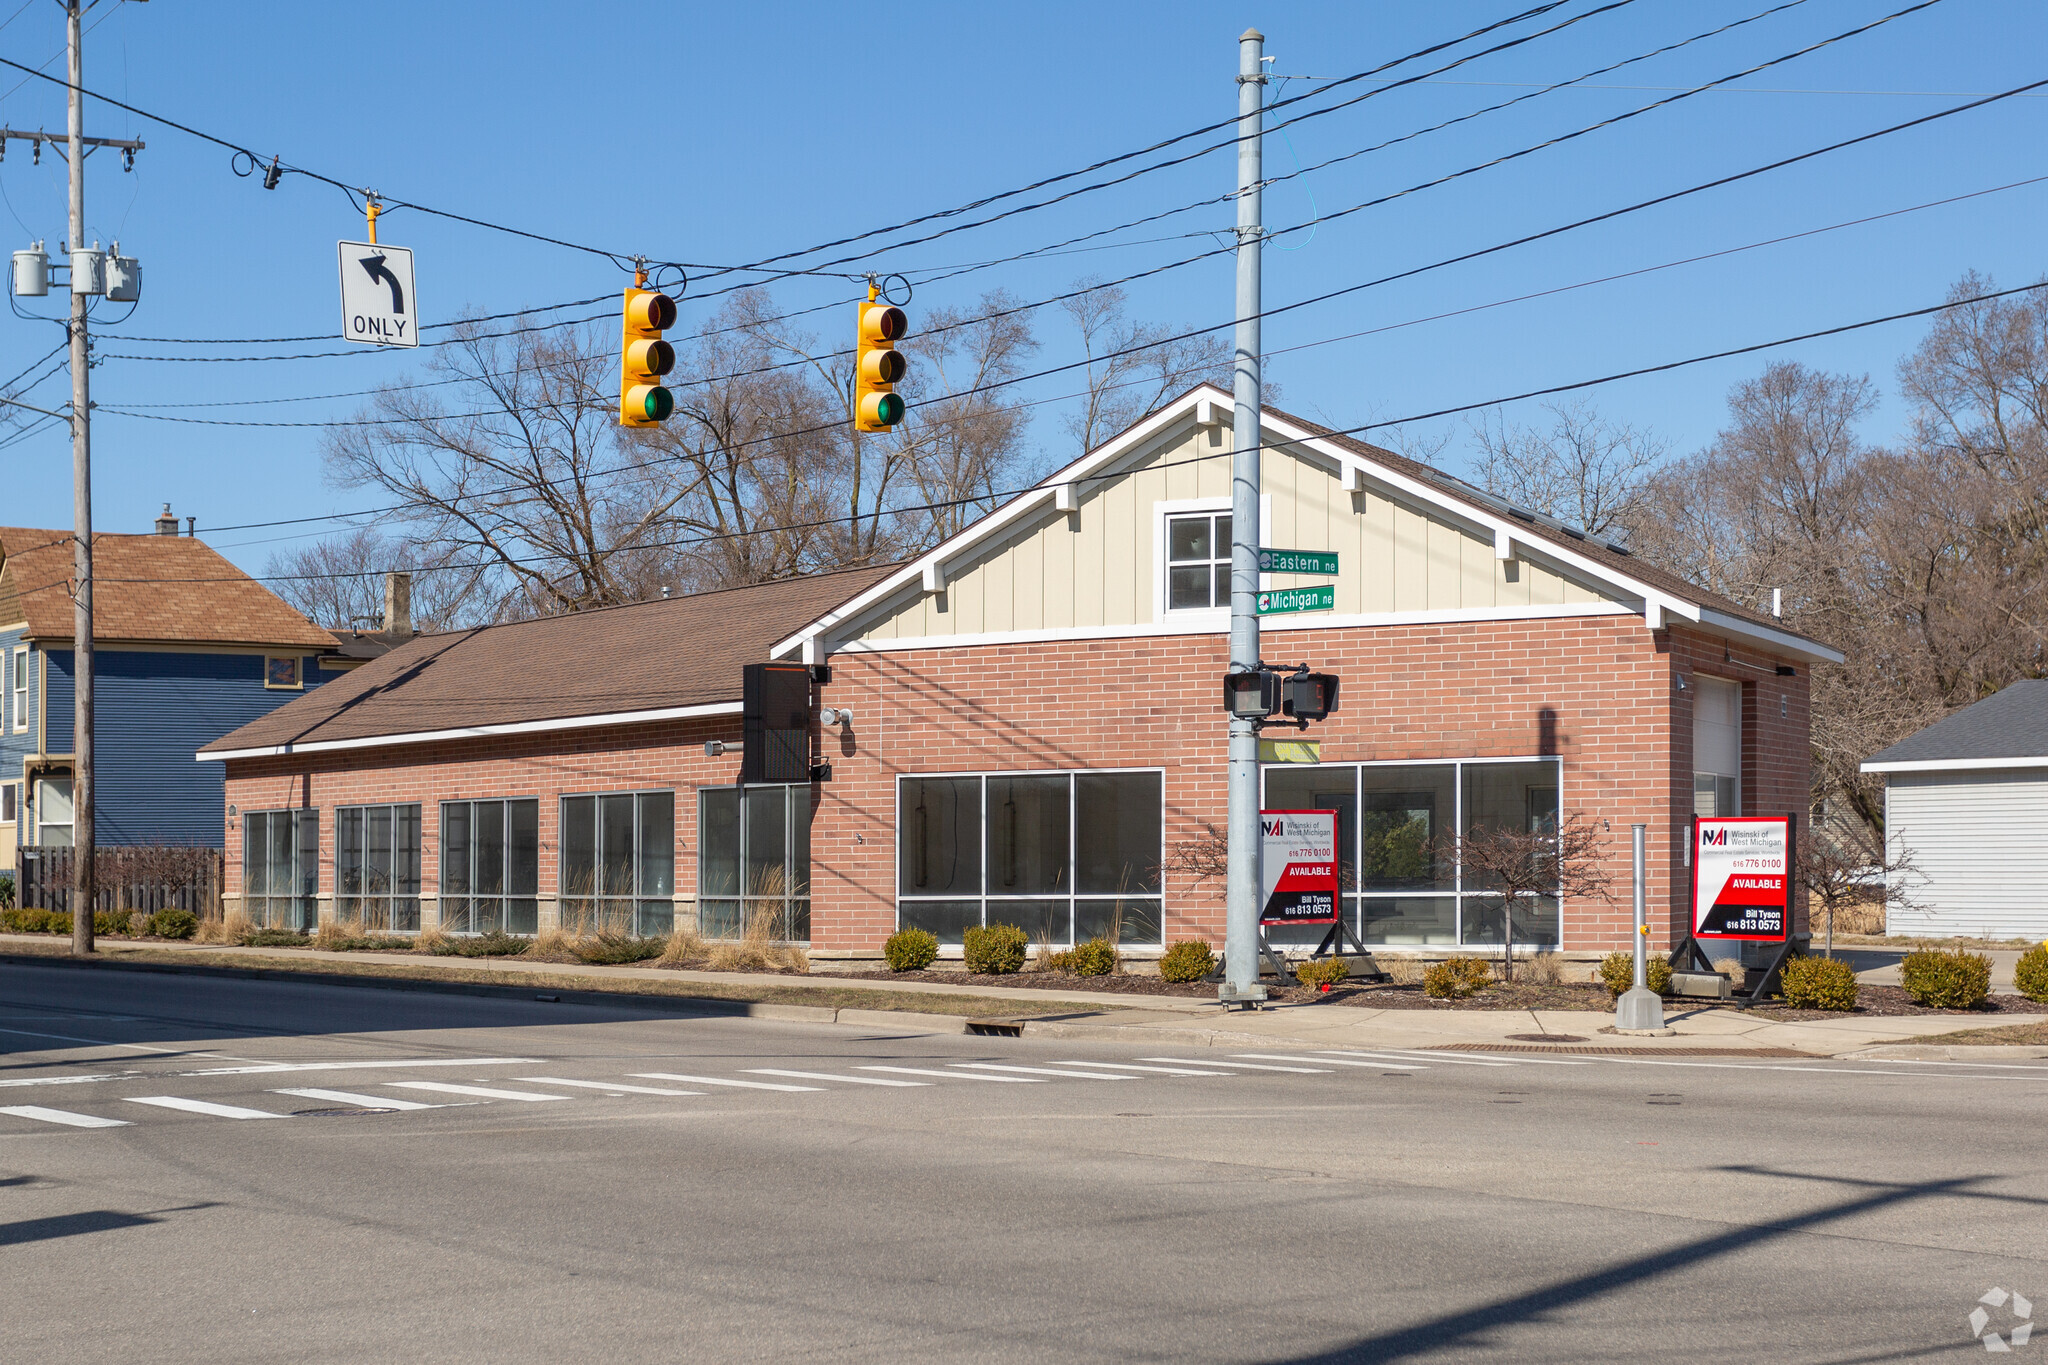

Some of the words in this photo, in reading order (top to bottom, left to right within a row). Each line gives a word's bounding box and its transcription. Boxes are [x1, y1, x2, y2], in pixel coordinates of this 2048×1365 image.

[354, 315, 406, 338] ONLY
[1272, 553, 1319, 571] Eastern
[1325, 562, 1335, 571] ne
[1271, 591, 1318, 610] Michigan
[1323, 595, 1332, 604] ne
[1262, 817, 1283, 836] NAI
[1303, 829, 1331, 838] Michigan
[1703, 826, 1727, 845] NAI
[1731, 830, 1761, 838] Wisinski
[1762, 830, 1769, 838] of
[1731, 838, 1748, 846] West
[1750, 838, 1782, 848] Michigan
[1300, 849, 1312, 857] 776
[1314, 848, 1331, 857] 0100
[1745, 859, 1760, 868] 776
[1761, 859, 1781, 868] 0100
[1289, 867, 1331, 876] AVAILABLE
[1733, 879, 1781, 889] AVAILABLE
[1301, 895, 1312, 903] Bill
[1313, 895, 1331, 904] Tyson
[1297, 905, 1311, 914] 813
[1313, 904, 1331, 914] 0573
[1745, 909, 1757, 918] Bill
[1758, 910, 1780, 920] Tyson
[1726, 921, 1738, 929] 616
[1740, 919, 1756, 929] 813
[1758, 920, 1780, 930] 0573
